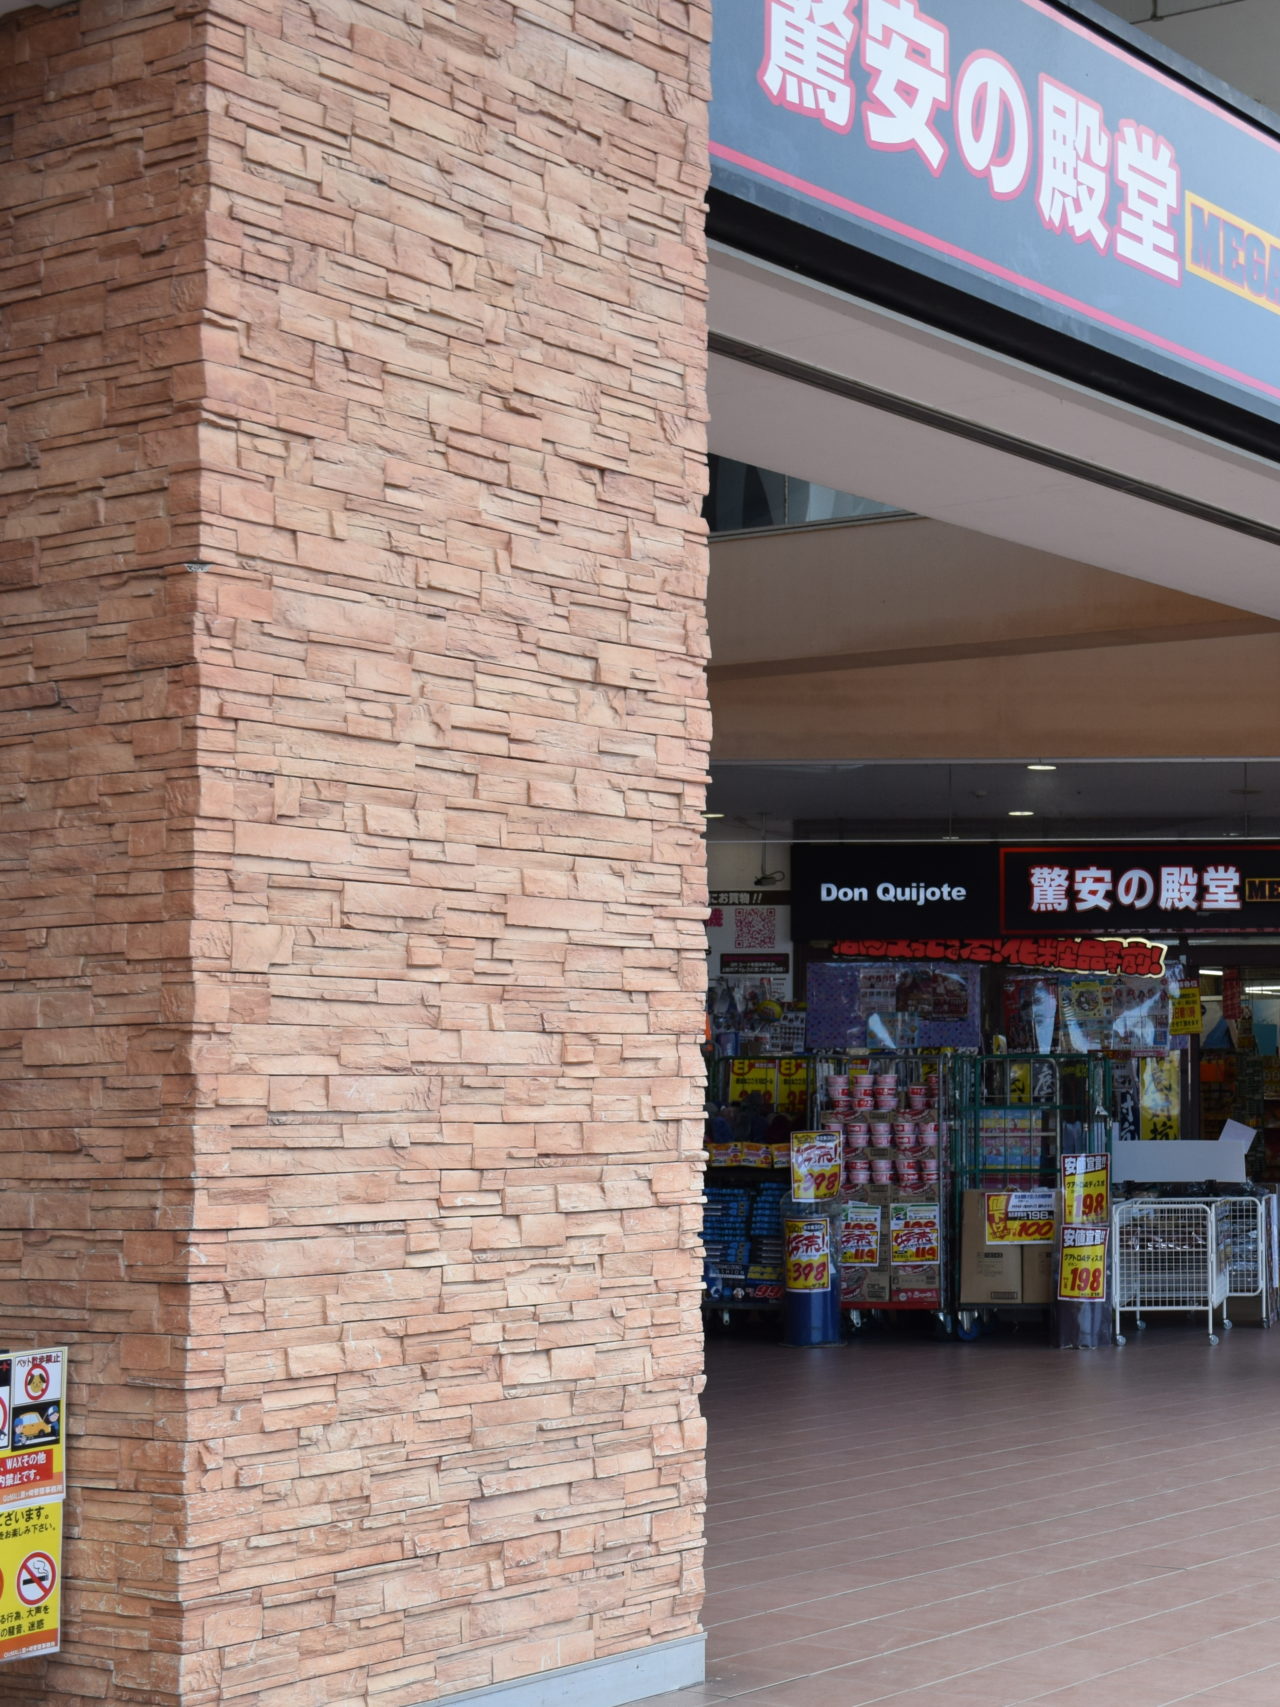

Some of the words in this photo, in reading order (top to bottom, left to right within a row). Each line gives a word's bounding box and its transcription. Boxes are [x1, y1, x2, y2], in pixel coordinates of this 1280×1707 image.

[820, 882, 869, 902] Don
[876, 882, 967, 906] Quijote
[1029, 865, 1242, 913] 驚安の殿堂
[1027, 1211, 1049, 1220] 198
[1074, 1193, 1105, 1218] 198
[792, 1262, 827, 1282] 398
[1070, 1267, 1102, 1292] 198
